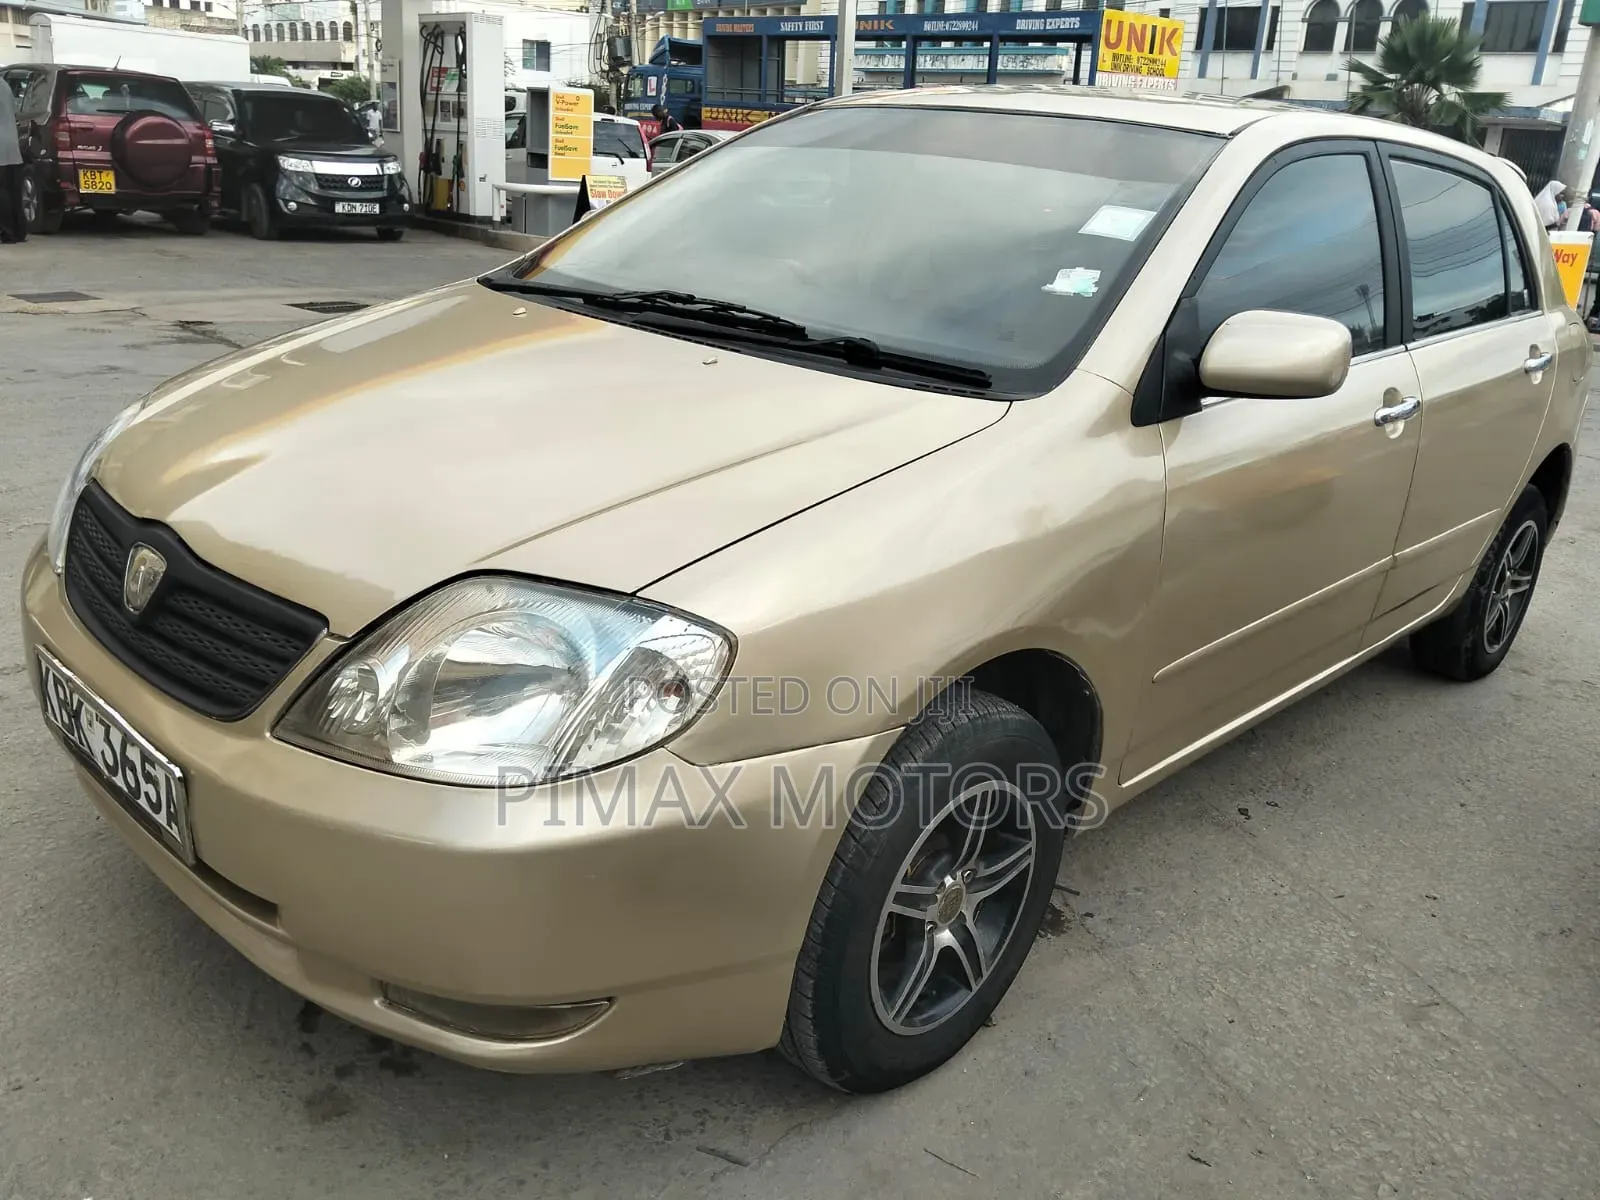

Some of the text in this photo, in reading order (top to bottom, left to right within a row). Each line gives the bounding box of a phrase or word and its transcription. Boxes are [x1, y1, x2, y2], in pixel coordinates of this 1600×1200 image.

[780, 21, 824, 31] SAFETY FIRST
[1016, 17, 1080, 29] DRIVING EXPERTS
[1105, 20, 1179, 56] UNIK
[555, 122, 579, 130] FuelSave
[83, 170, 103, 180] KBT
[39, 662, 94, 756] KBK
